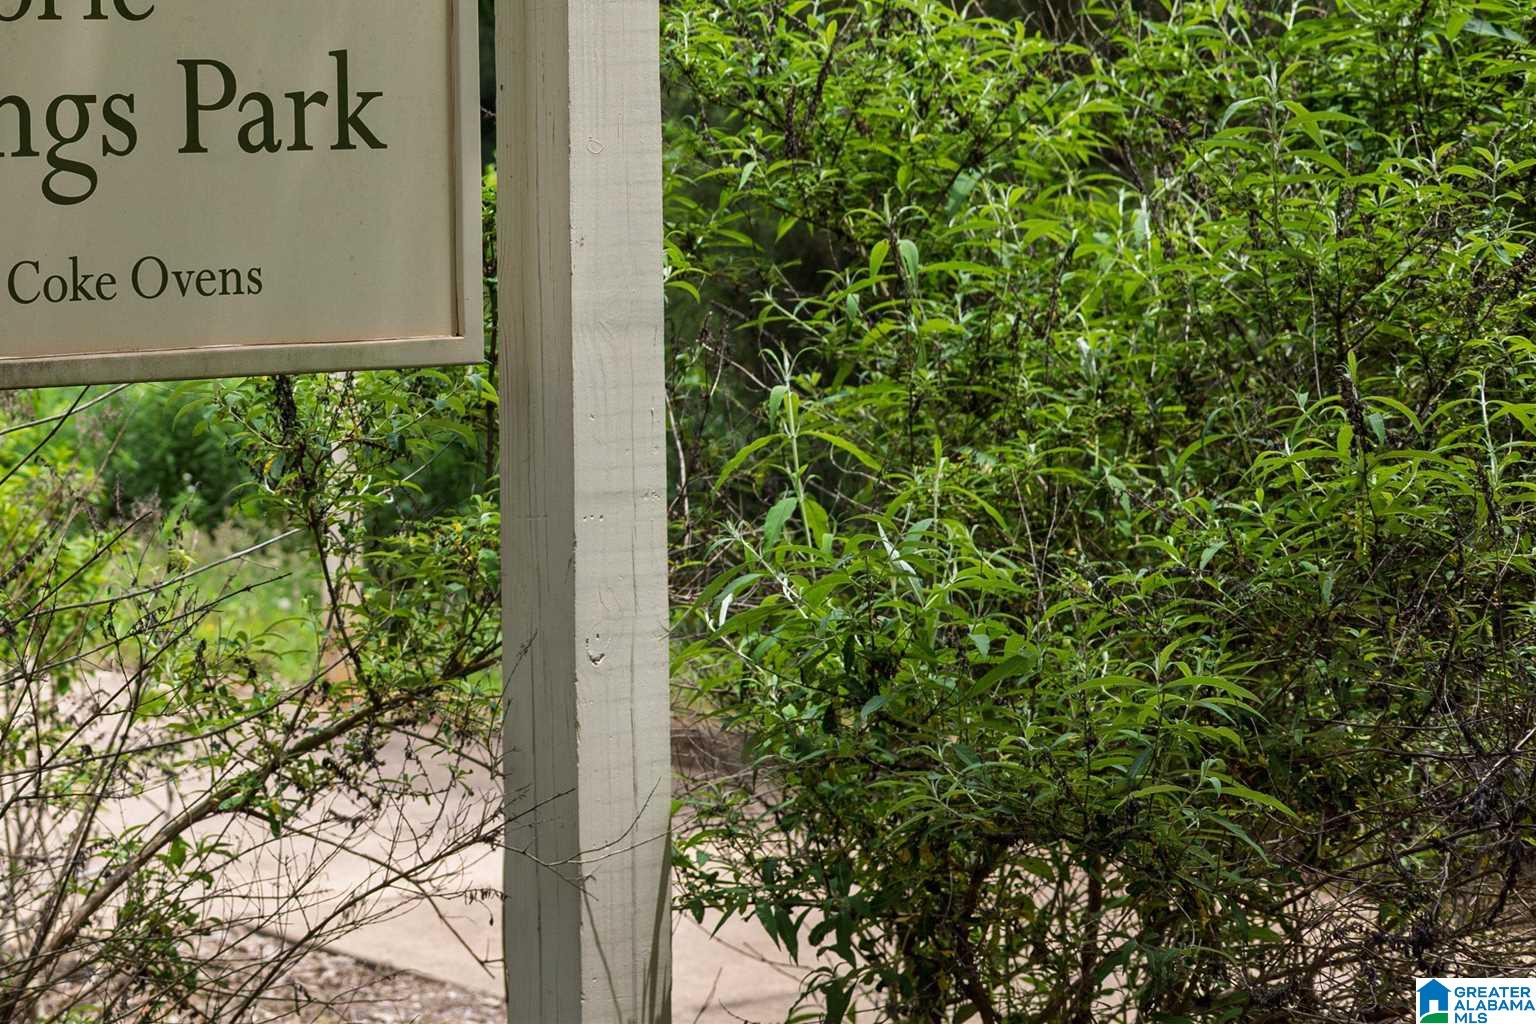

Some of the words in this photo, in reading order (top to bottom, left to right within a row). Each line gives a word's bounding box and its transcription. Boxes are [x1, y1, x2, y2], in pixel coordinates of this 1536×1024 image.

[177, 49, 388, 153] Park
[8, 256, 117, 304] Coke
[132, 256, 262, 299] Ovens
